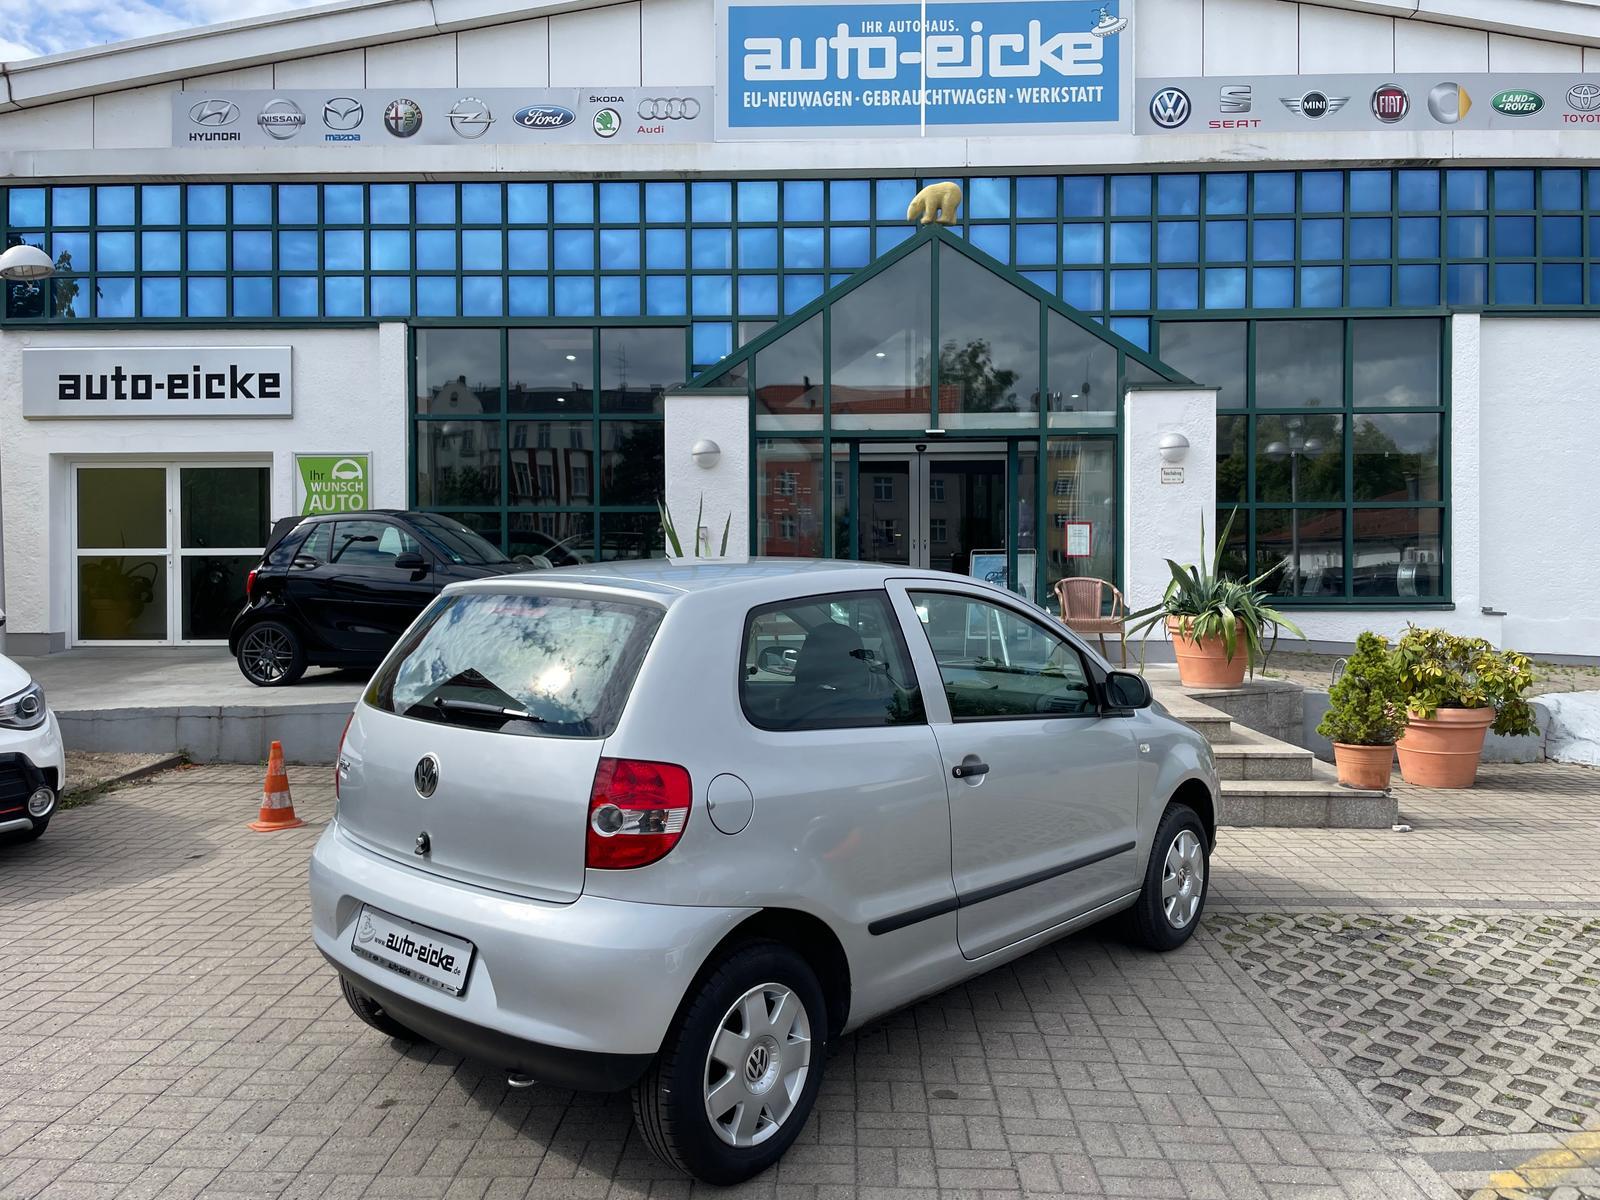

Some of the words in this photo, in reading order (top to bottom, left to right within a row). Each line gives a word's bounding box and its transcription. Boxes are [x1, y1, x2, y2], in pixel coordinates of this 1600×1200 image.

[861, 21, 882, 33] IHR
[744, 20, 1104, 80] auto-eicke
[1016, 86, 1104, 103] WERKSTATT
[1502, 94, 1528, 102] LAND
[1304, 101, 1326, 110] MINI
[1380, 96, 1402, 112] FIAT
[1504, 102, 1537, 110] ROVER
[262, 116, 302, 124] NISSAN
[524, 109, 563, 126] Ford
[1208, 120, 1262, 128] SEAT
[637, 125, 664, 134] Audi
[189, 132, 241, 142] HYUNDAI
[325, 134, 361, 142] mazda
[58, 364, 280, 400] auto-eicke
[310, 470, 324, 480] Ihr
[310, 482, 364, 492] WUNSCH
[309, 494, 364, 512] AUTO
